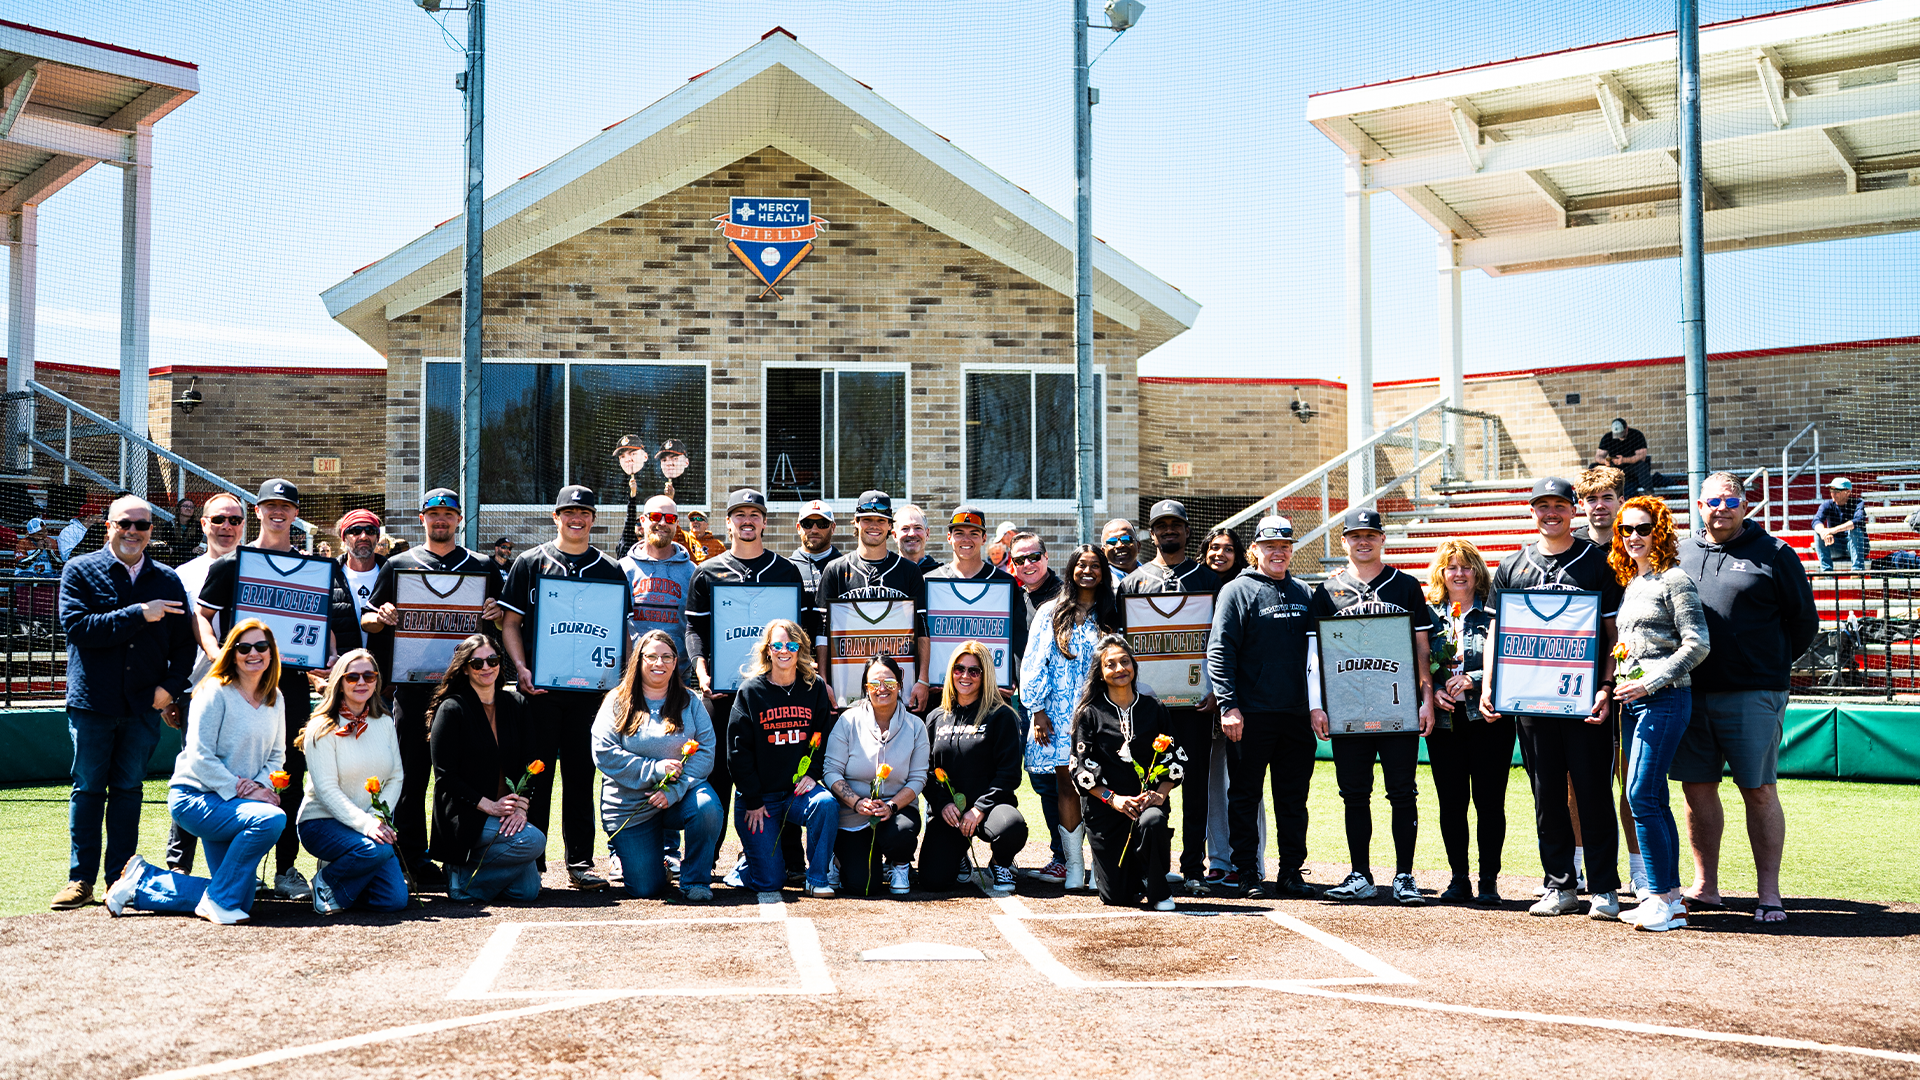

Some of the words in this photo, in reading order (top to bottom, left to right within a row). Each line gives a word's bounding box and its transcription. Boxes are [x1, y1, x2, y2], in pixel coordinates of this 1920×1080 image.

[758, 203, 799, 212] MERCY
[758, 213, 805, 222] HEALTH
[740, 228, 802, 240] FIELD
[318, 459, 336, 471] EXIT
[1172, 463, 1188, 476] EXIT
[632, 577, 682, 599] LOURDES
[241, 584, 274, 606] GRAY
[275, 589, 321, 613] WOLVES
[403, 611, 433, 630] GRAY
[435, 612, 478, 632] WOLVES
[633, 609, 679, 623] BASEBALL
[291, 623, 320, 647] 25
[549, 620, 609, 640] LOURDES
[725, 625, 766, 642] LOUR
[934, 617, 962, 635] GRAY
[964, 618, 1005, 637] WOLVES
[839, 637, 867, 657] GRAY
[869, 636, 910, 656] WOLVES
[1133, 634, 1162, 653] GRAY
[1164, 632, 1207, 652] WOLVES
[1504, 635, 1537, 657] GRAY
[1539, 637, 1587, 660] WOLVES
[591, 645, 617, 669] 45
[1336, 657, 1401, 674] LOURDES
[1187, 663, 1202, 687] 5
[1557, 672, 1585, 697] 31
[1391, 681, 1401, 705] 1
[759, 705, 812, 724] LOURDES
[763, 720, 810, 730] BASEBALL
[774, 729, 801, 746] LU
